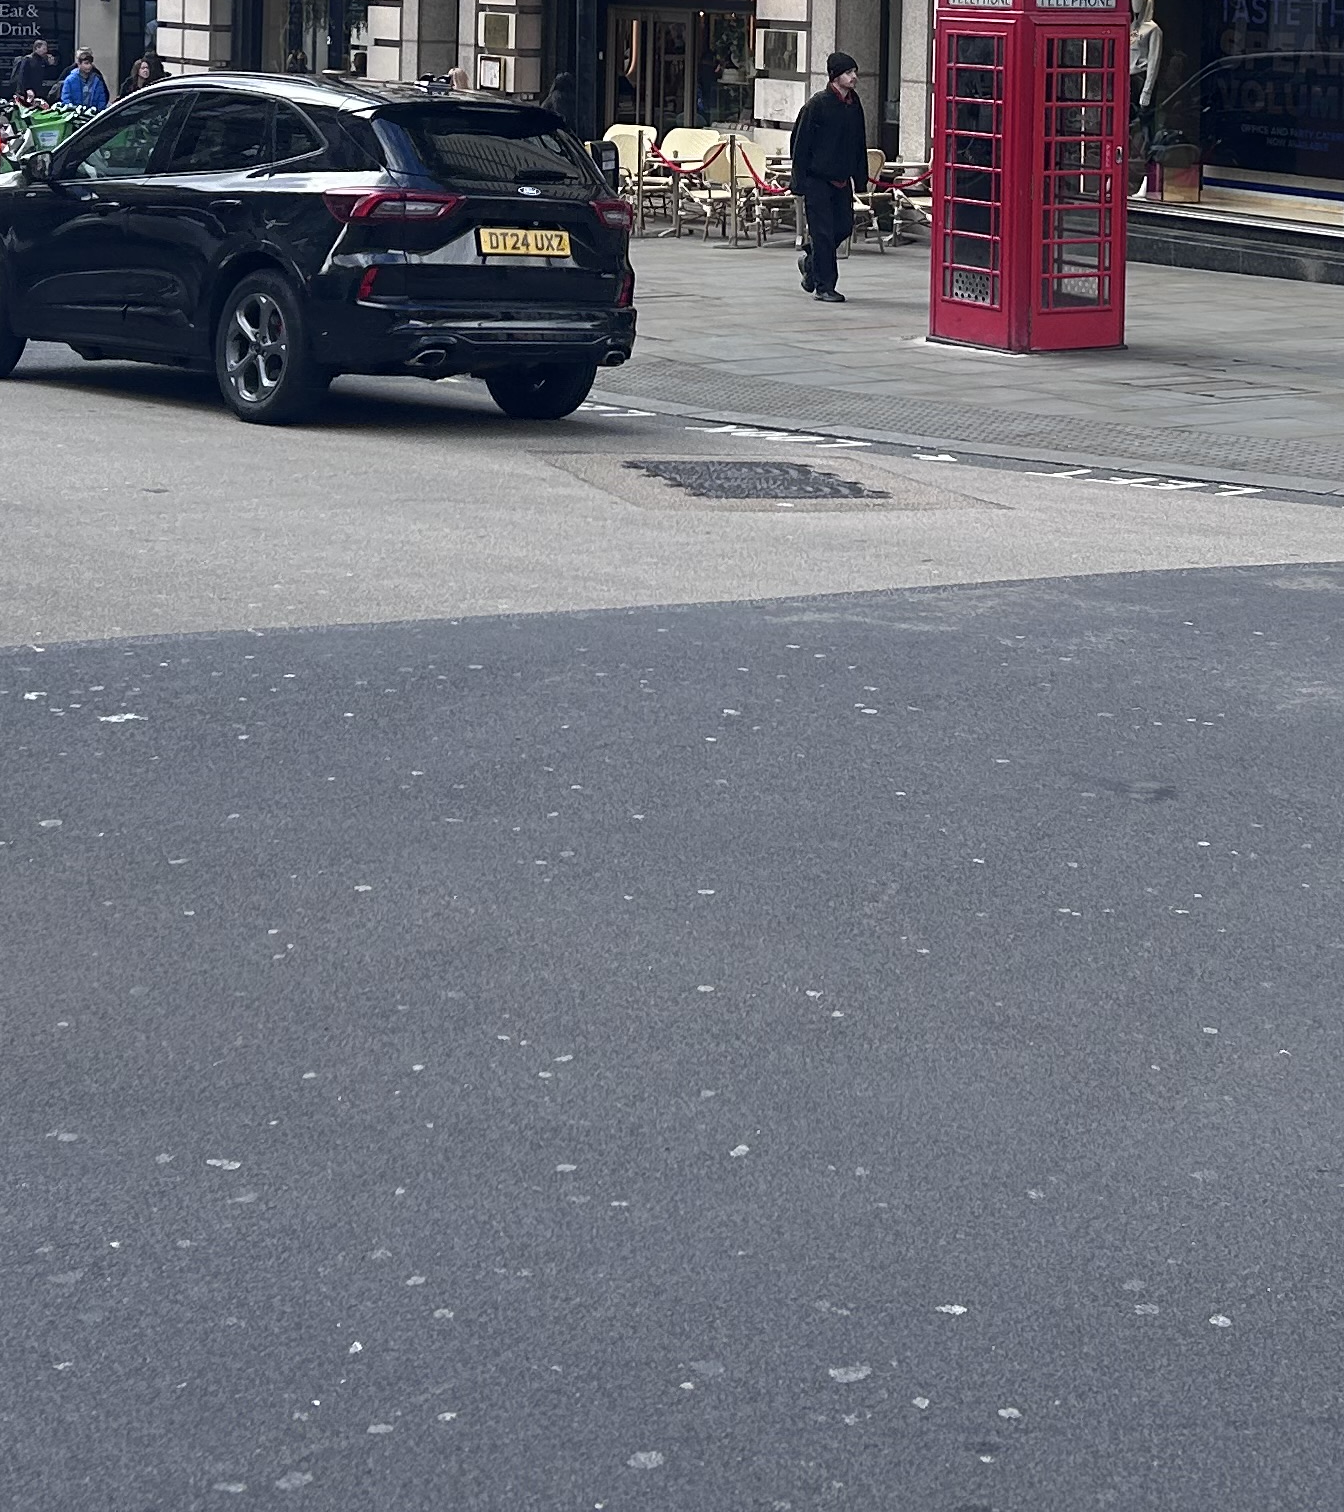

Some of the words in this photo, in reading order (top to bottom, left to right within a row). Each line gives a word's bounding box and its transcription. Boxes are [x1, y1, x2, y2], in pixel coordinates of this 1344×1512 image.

[26, 4, 40, 18] &
[1271, 126, 1288, 136] AND
[488, 232, 531, 251] DT24
[534, 233, 566, 252] UXZ
[1025, 469, 1266, 497] LEFT
